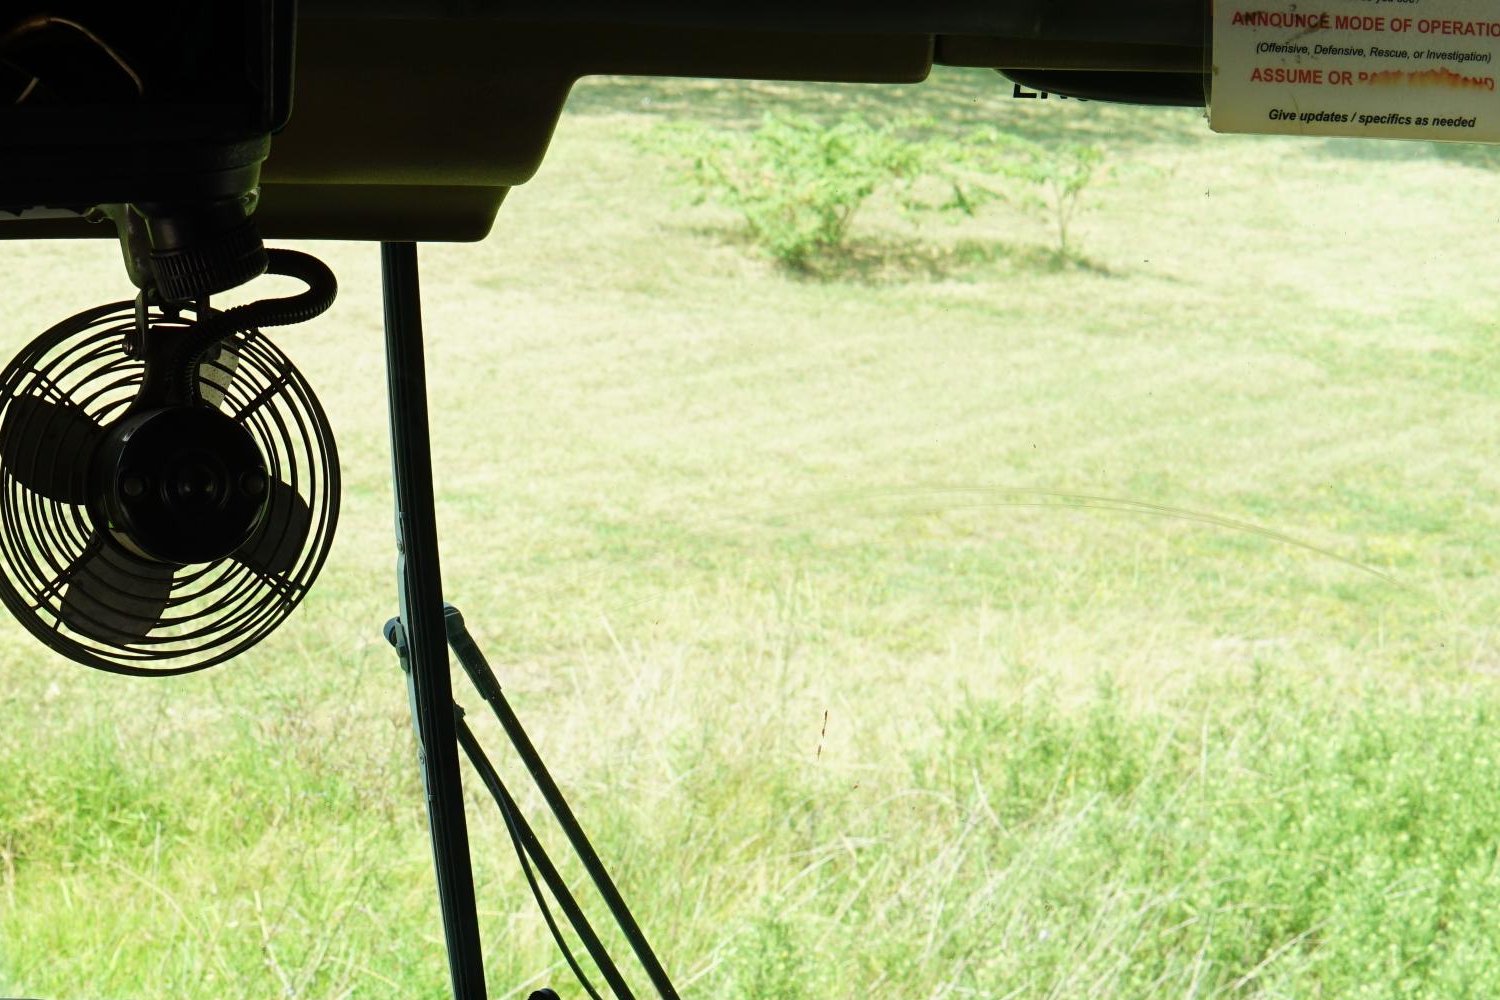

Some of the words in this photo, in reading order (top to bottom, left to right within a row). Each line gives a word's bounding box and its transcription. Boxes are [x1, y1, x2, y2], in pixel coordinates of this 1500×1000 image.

[1232, 11, 1330, 28] ANNOUNCE
[1335, 15, 1384, 31] MODE
[1390, 18, 1412, 32] OF
[1256, 42, 1311, 56] (Offensive,
[1314, 44, 1366, 58] Defensive,
[1370, 47, 1410, 59] Rescue,
[1414, 50, 1424, 58] or
[1426, 50, 1492, 63] Investigation)
[1250, 68, 1322, 84] ASSUME
[1328, 70, 1352, 84] OR
[1269, 108, 1296, 120] Give
[1300, 112, 1348, 124] updates
[1350, 112, 1357, 122] /
[1358, 113, 1412, 126] specifics
[1415, 118, 1428, 126] as
[1432, 116, 1476, 128] needed
